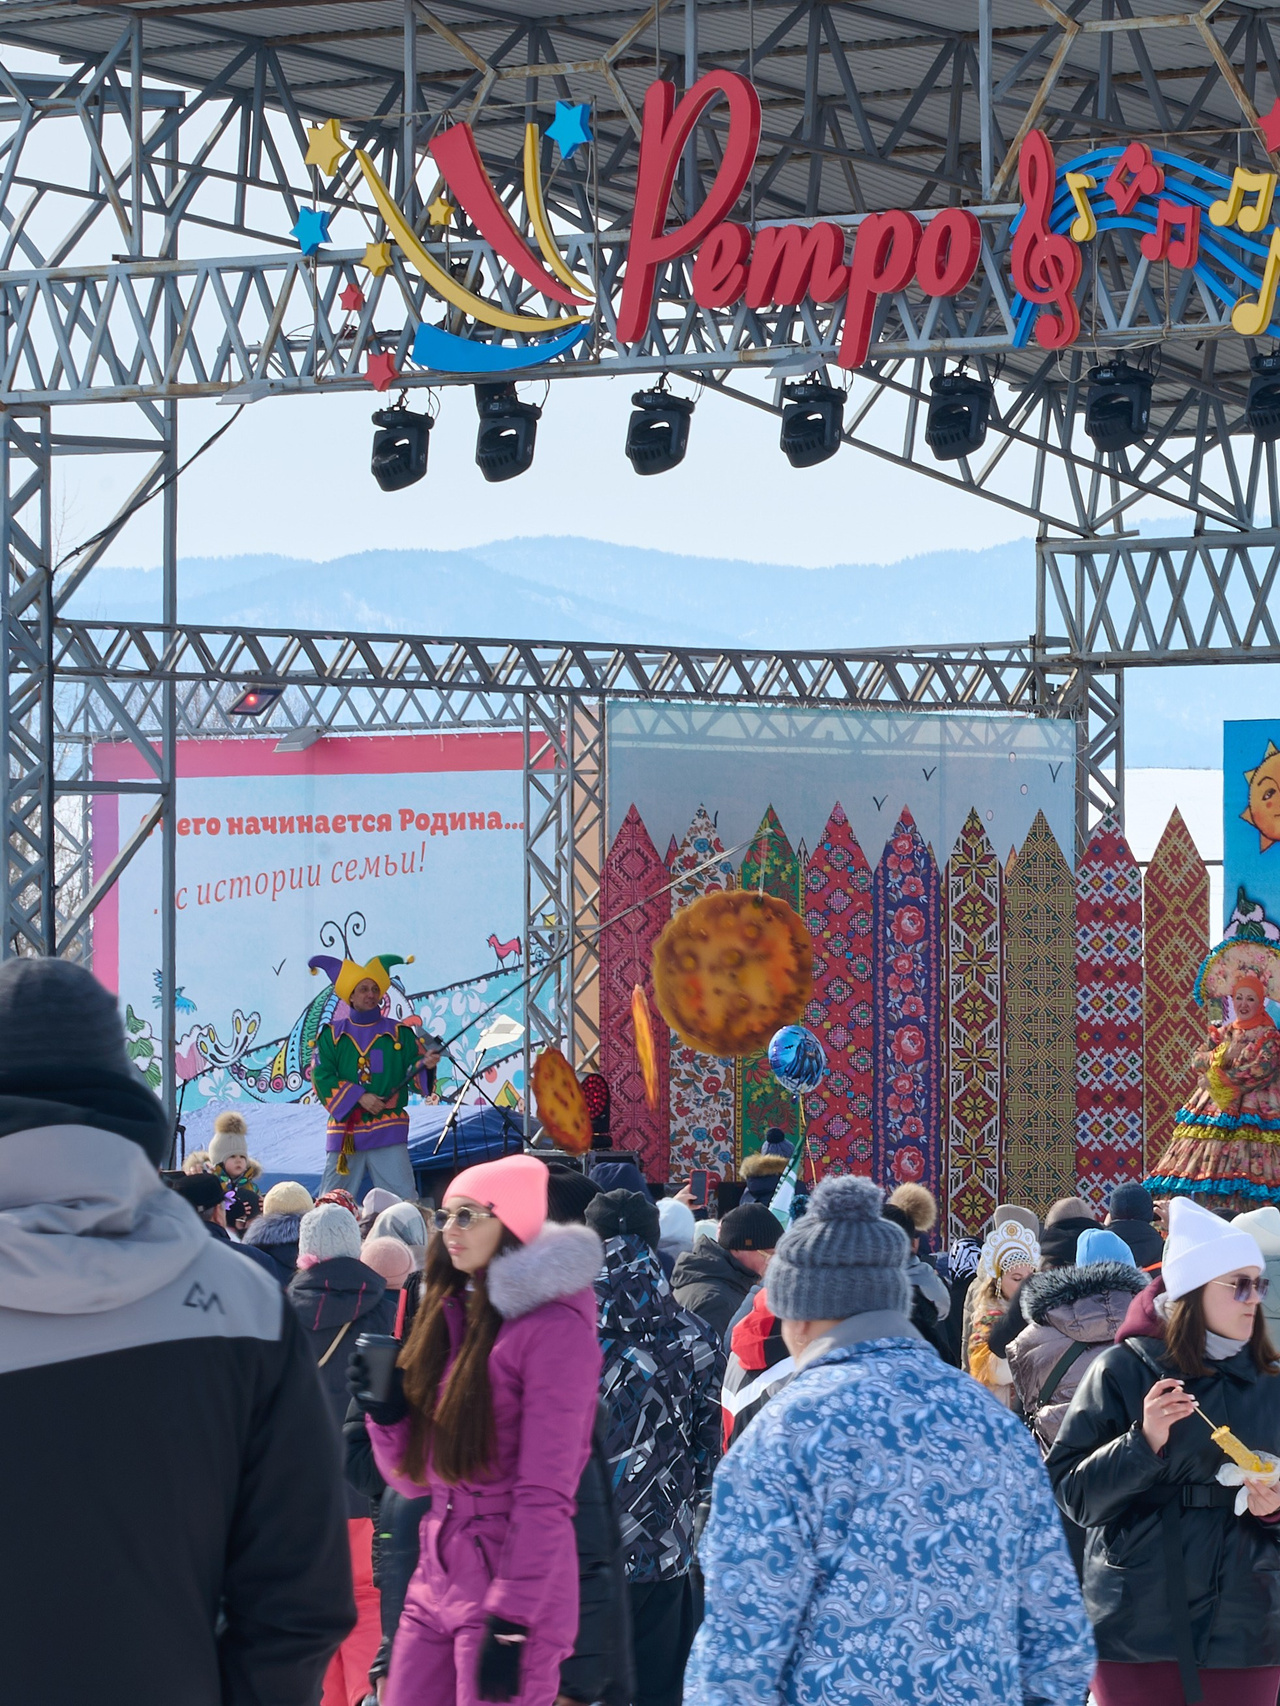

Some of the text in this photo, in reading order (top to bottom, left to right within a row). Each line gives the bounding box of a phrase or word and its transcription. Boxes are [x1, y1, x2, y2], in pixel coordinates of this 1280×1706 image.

[616, 69, 982, 369] Ретро
[226, 813, 392, 836] начинается
[197, 864, 321, 905] истории
[331, 841, 426, 884] семьи!
